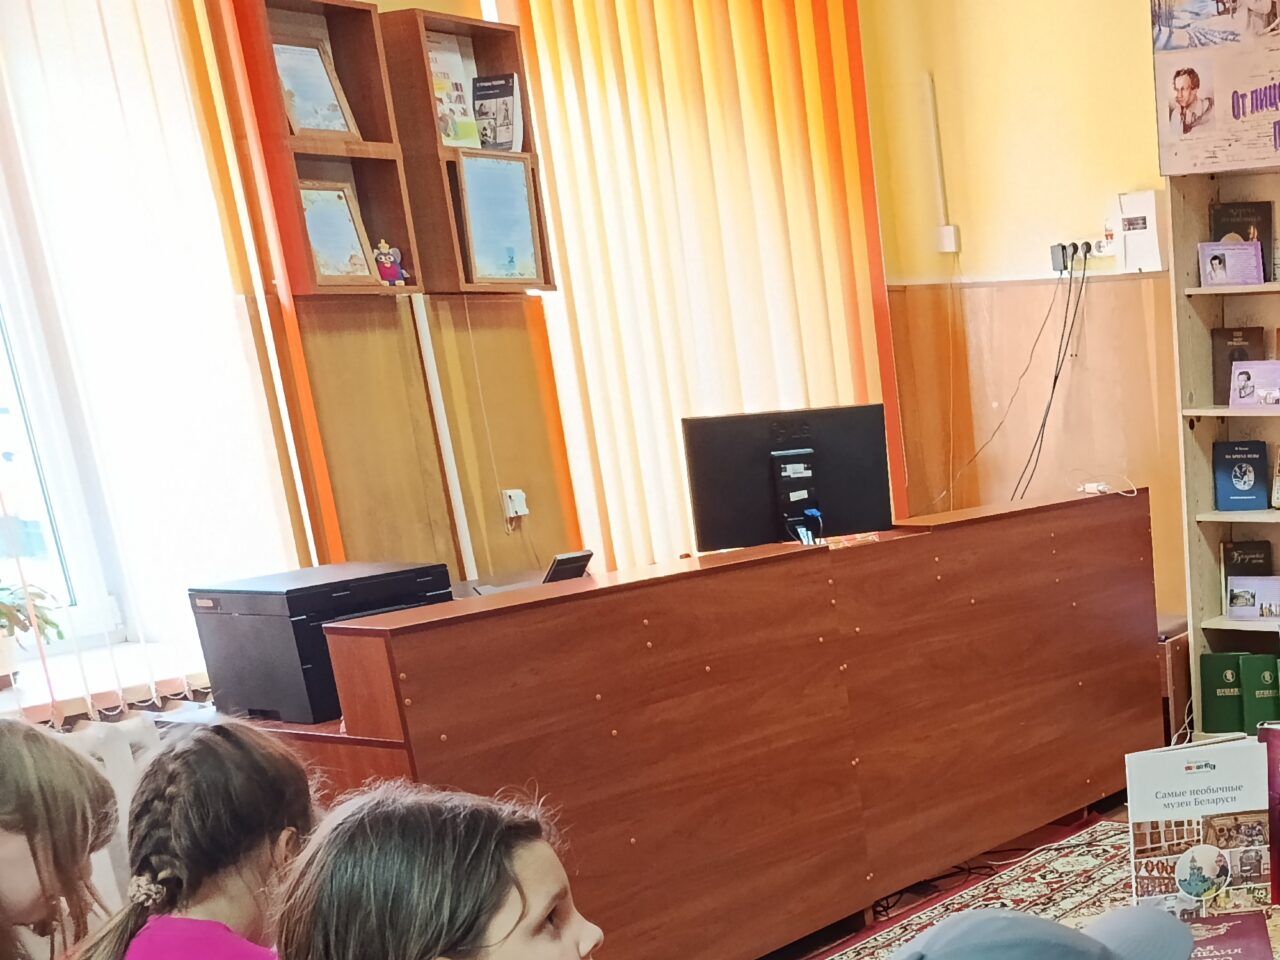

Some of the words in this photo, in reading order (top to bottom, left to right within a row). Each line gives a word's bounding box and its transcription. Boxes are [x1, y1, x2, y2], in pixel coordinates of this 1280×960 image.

[1231, 90, 1248, 120] От
[1155, 790, 1187, 800] Самые
[1189, 784, 1244, 796] необычные
[1194, 795, 1237, 807] Беларуси
